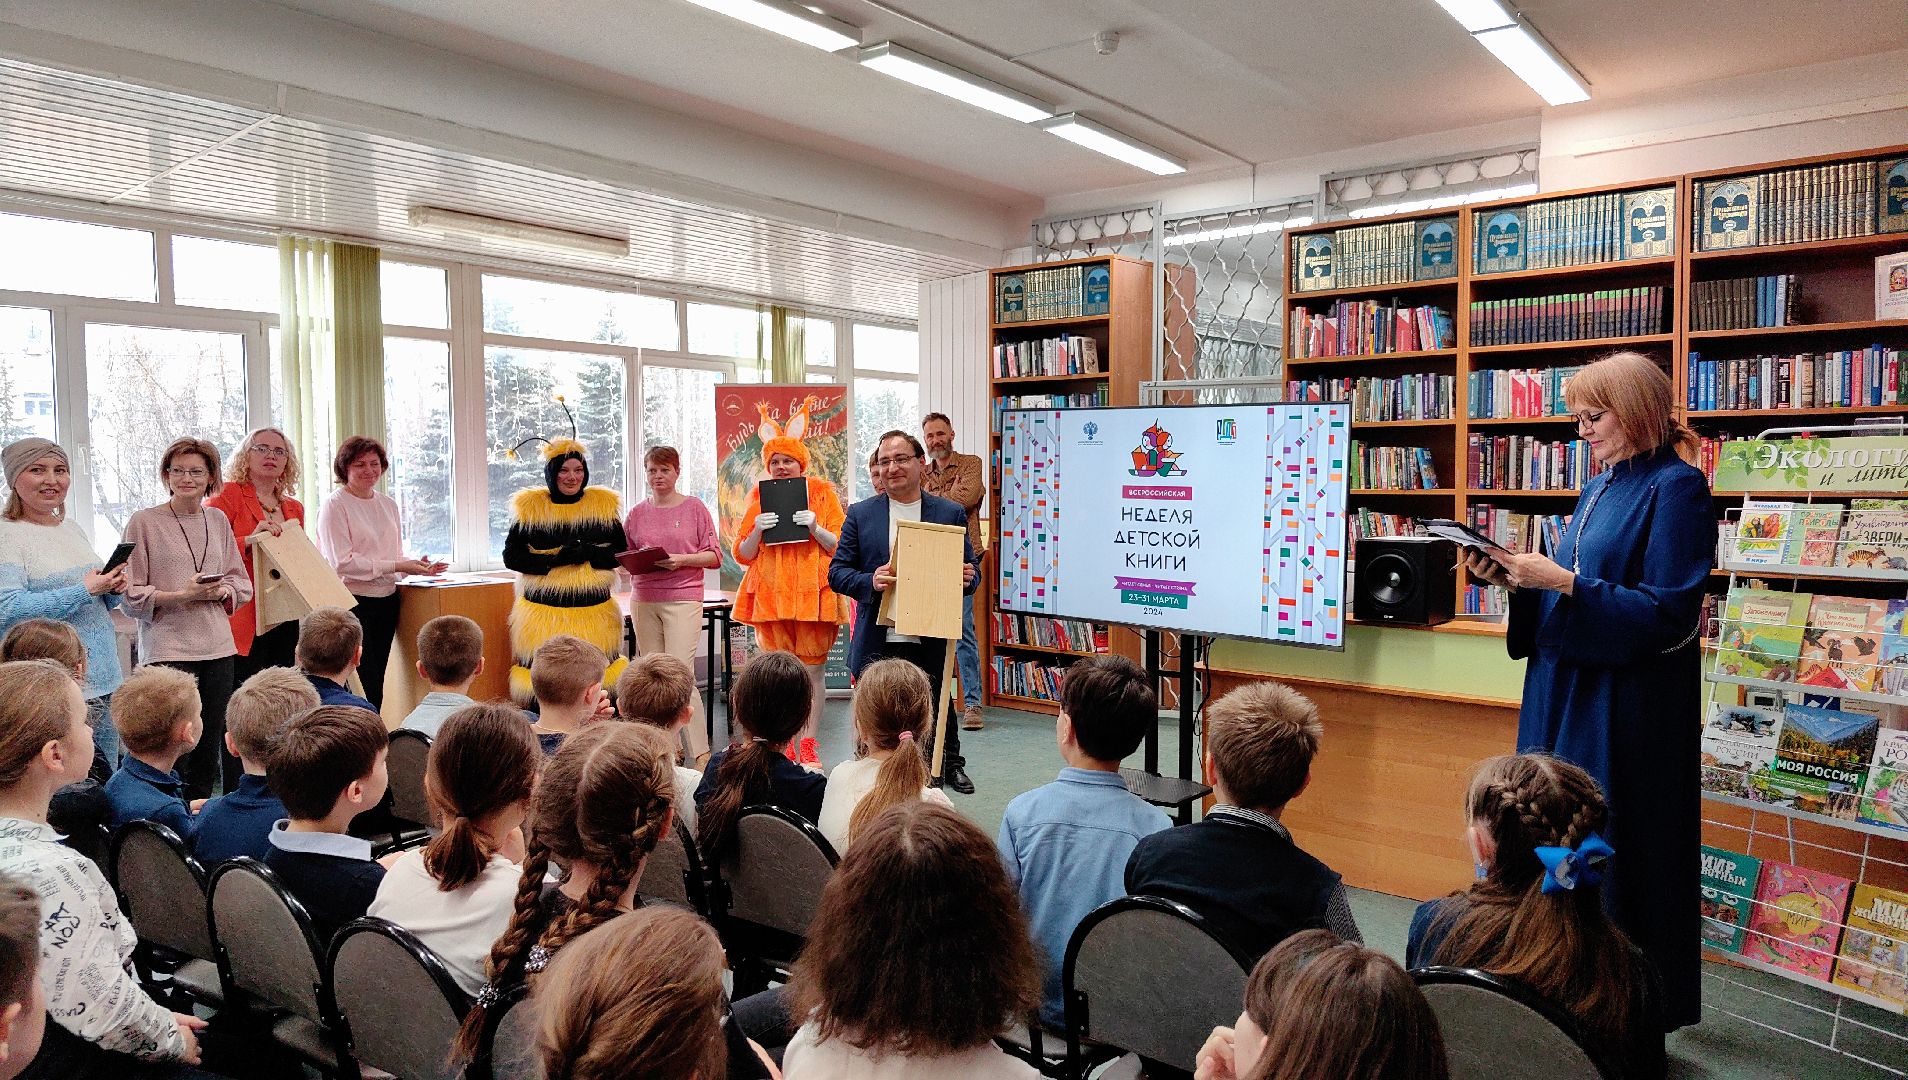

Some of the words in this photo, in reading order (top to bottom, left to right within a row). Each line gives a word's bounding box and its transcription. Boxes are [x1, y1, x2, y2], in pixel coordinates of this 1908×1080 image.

[725, 422, 755, 452] Будь
[790, 396, 831, 414] воне
[804, 417, 830, 440] ай!
[1819, 472, 1835, 486] и
[1847, 464, 1908, 484] лите
[1128, 489, 1186, 498] ВСЕРОССИЙСКАЯ
[1121, 506, 1192, 524] НЕДЕЛЯ
[1113, 529, 1200, 549] ДЕТСКОЙ
[1862, 530, 1903, 547] ЗВЕРИ
[1125, 552, 1186, 572] КНИГИ
[1152, 595, 1180, 606] МАРТА
[1143, 606, 1163, 616] 2024
[1776, 759, 1804, 773] МОЯ
[1807, 766, 1859, 784] РОССИЯ
[1701, 867, 1747, 887] ВОТНЫХ
